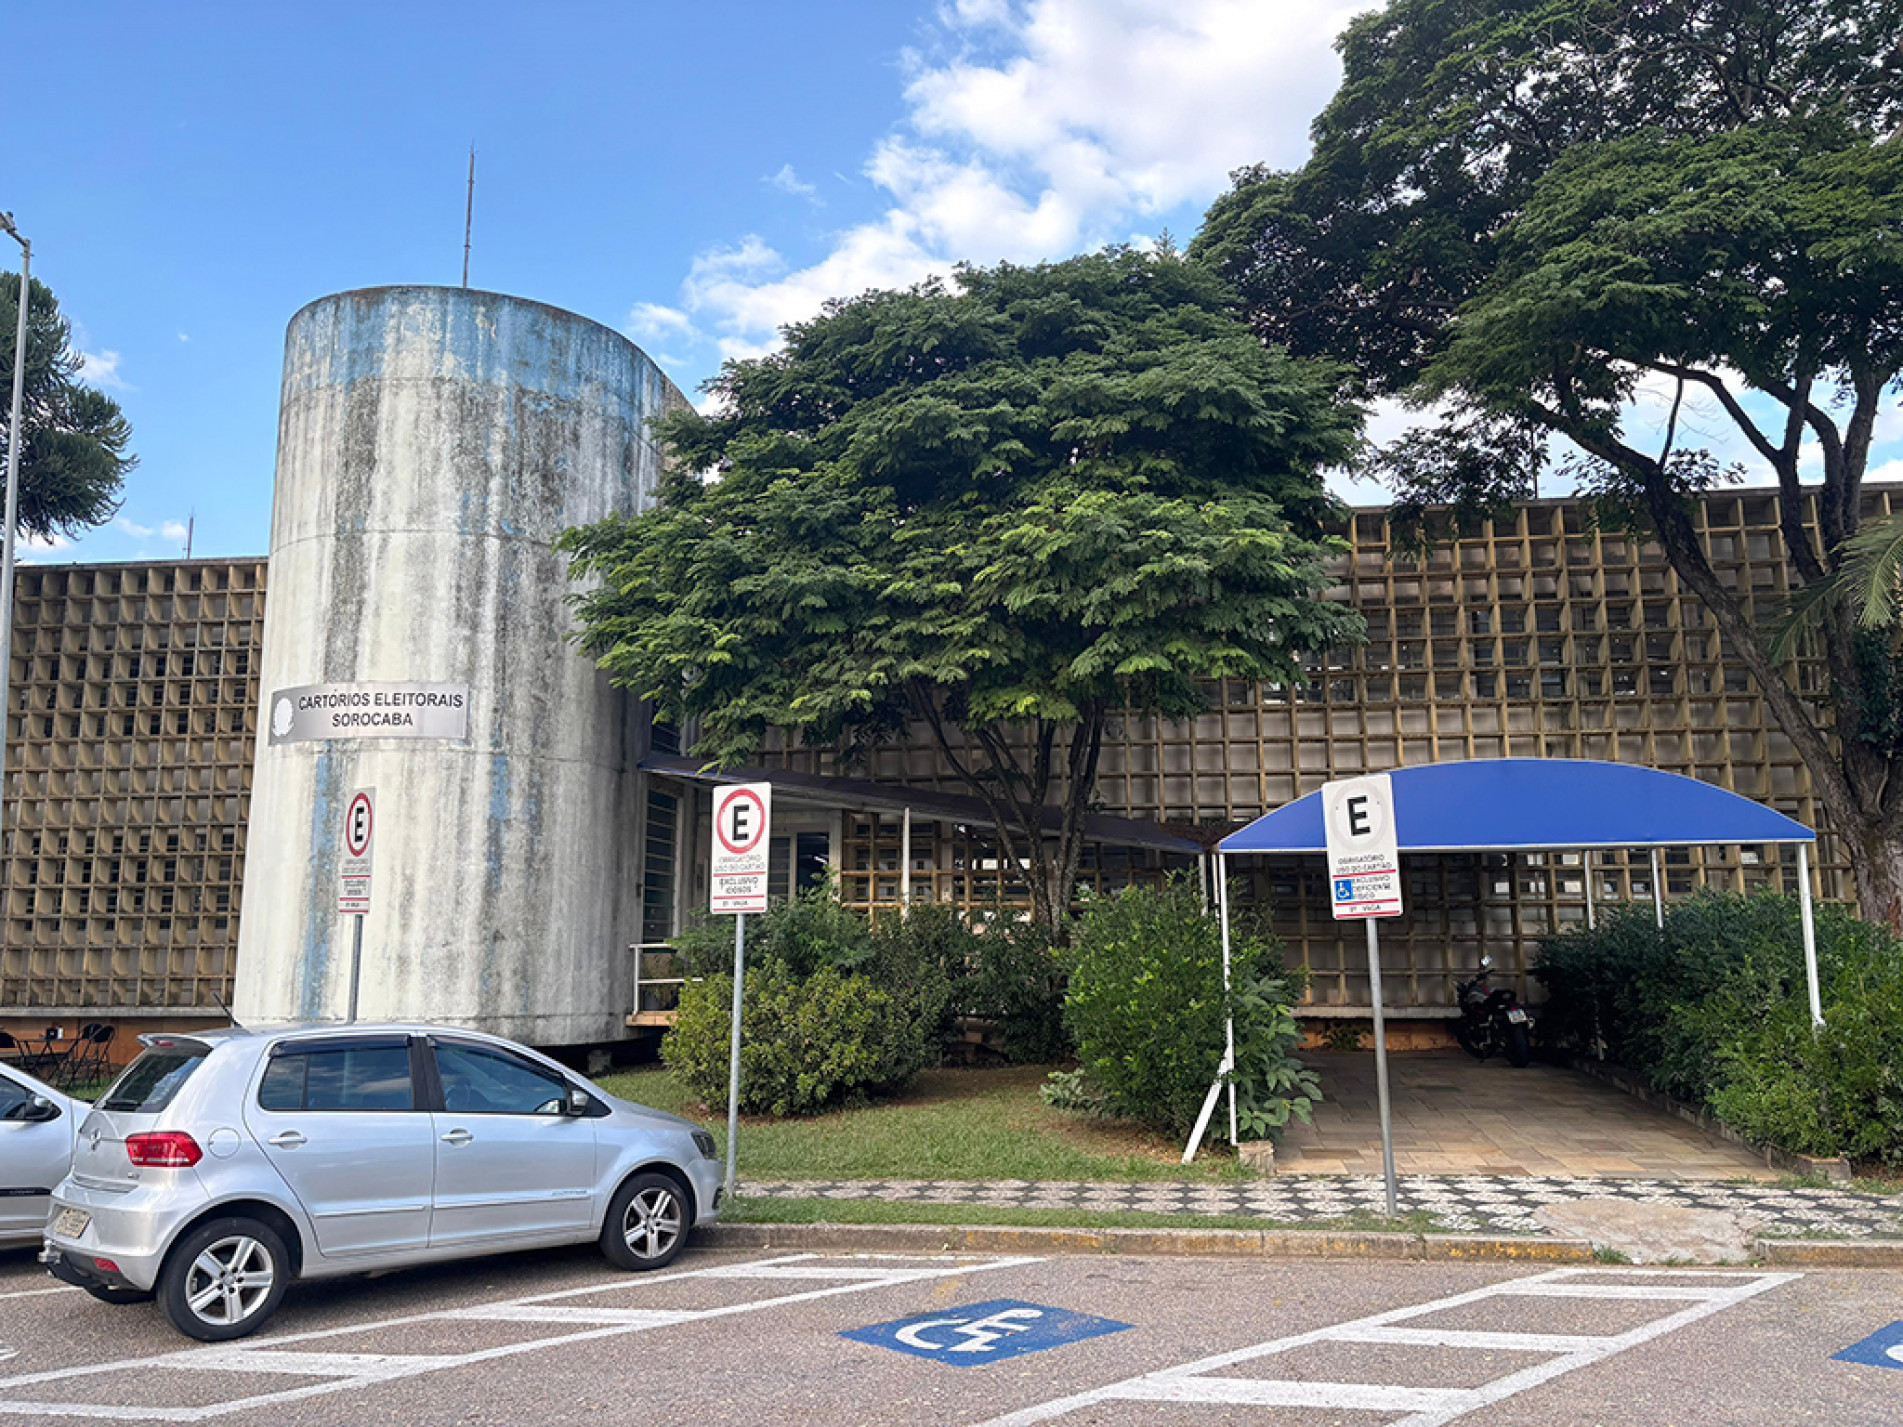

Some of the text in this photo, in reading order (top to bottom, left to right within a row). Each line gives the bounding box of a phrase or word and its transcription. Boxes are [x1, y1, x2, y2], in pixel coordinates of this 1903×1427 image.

[299, 688, 464, 710] CARTÓRIOS ELEITORAIS
[332, 712, 413, 727] SOROCABA
[354, 806, 365, 842] E
[732, 804, 750, 841] E
[1346, 795, 1371, 837] E
